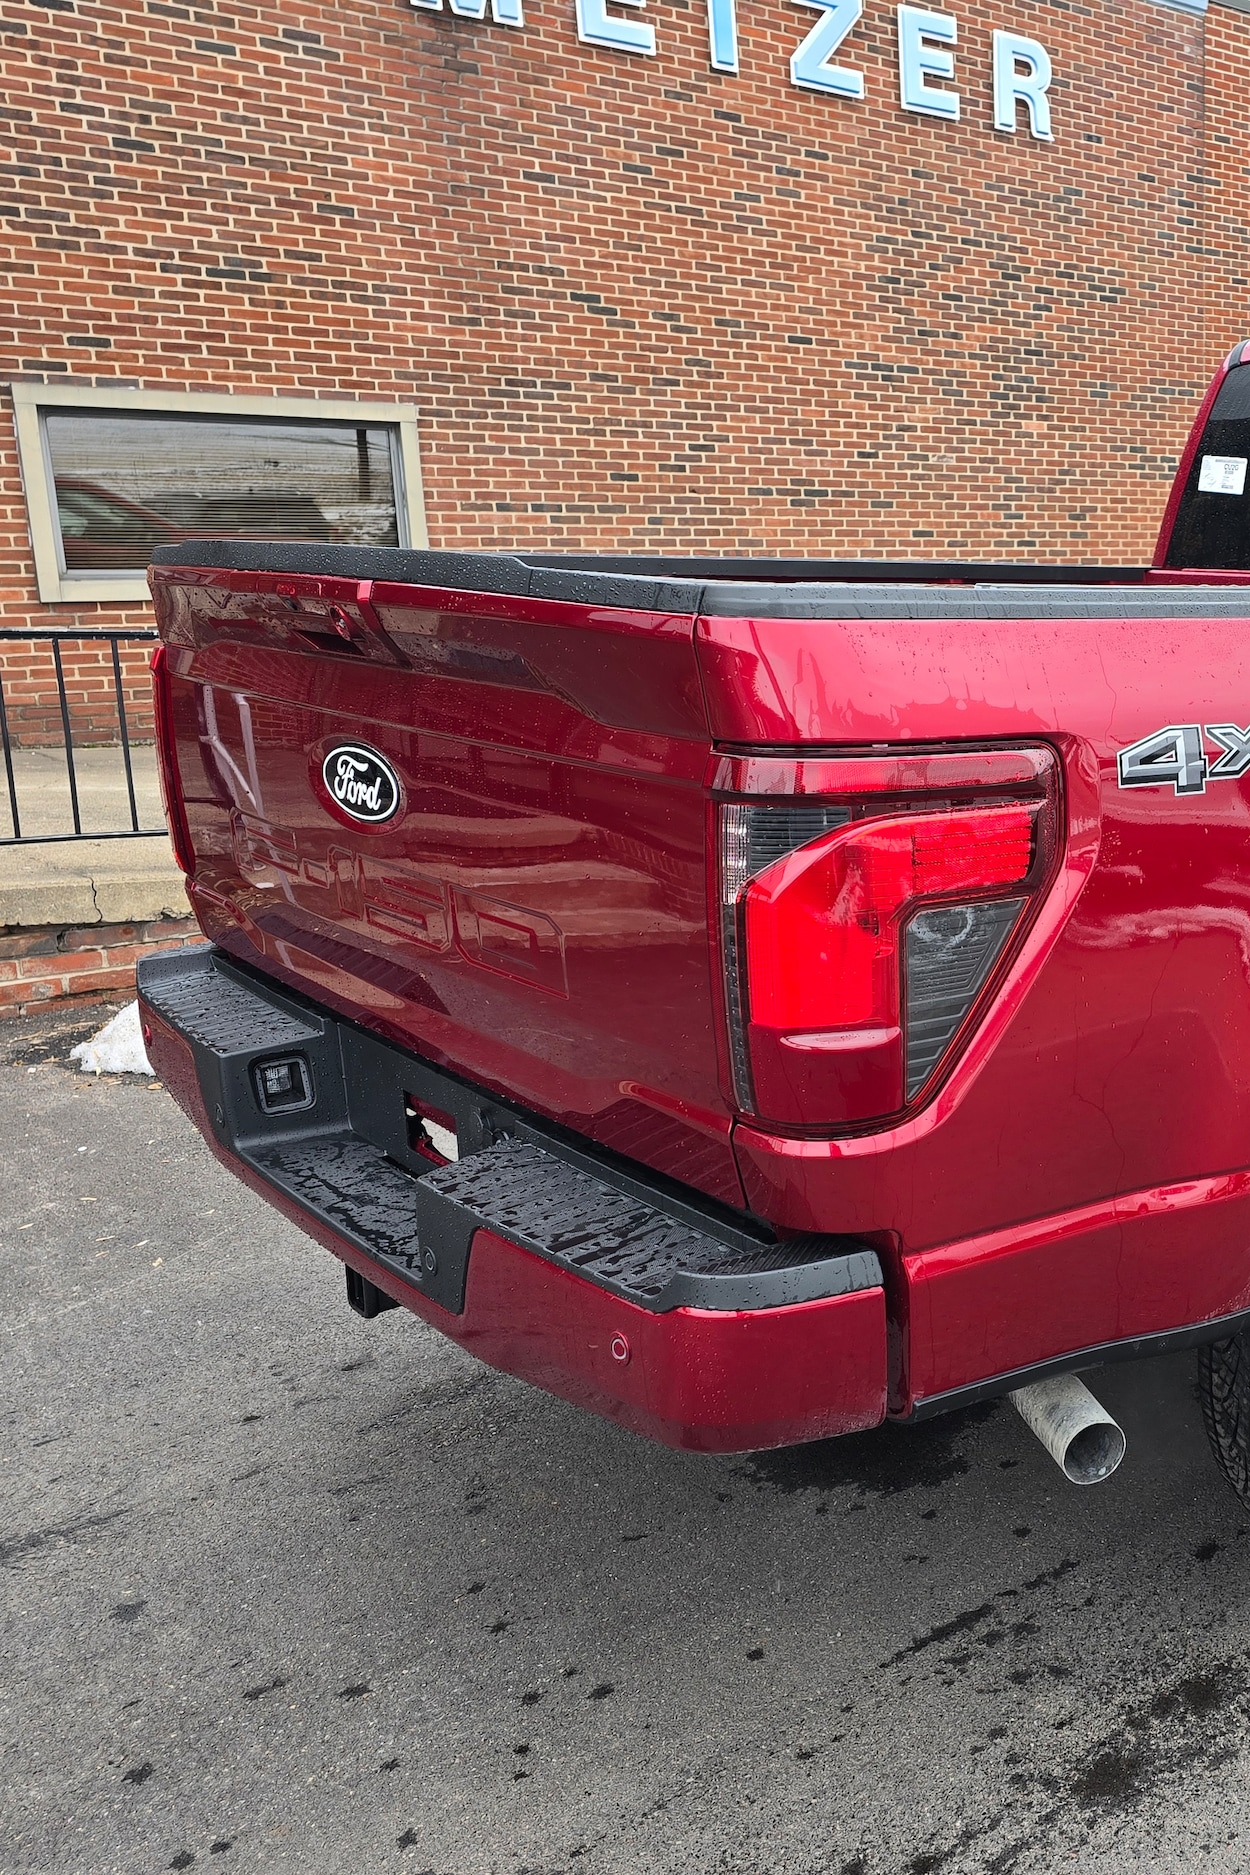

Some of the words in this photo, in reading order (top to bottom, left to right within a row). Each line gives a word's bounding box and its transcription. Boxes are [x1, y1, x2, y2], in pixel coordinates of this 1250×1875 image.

[408, 0, 1054, 140] TZER
[333, 754, 382, 811] Ford
[230, 806, 569, 999] F-150
